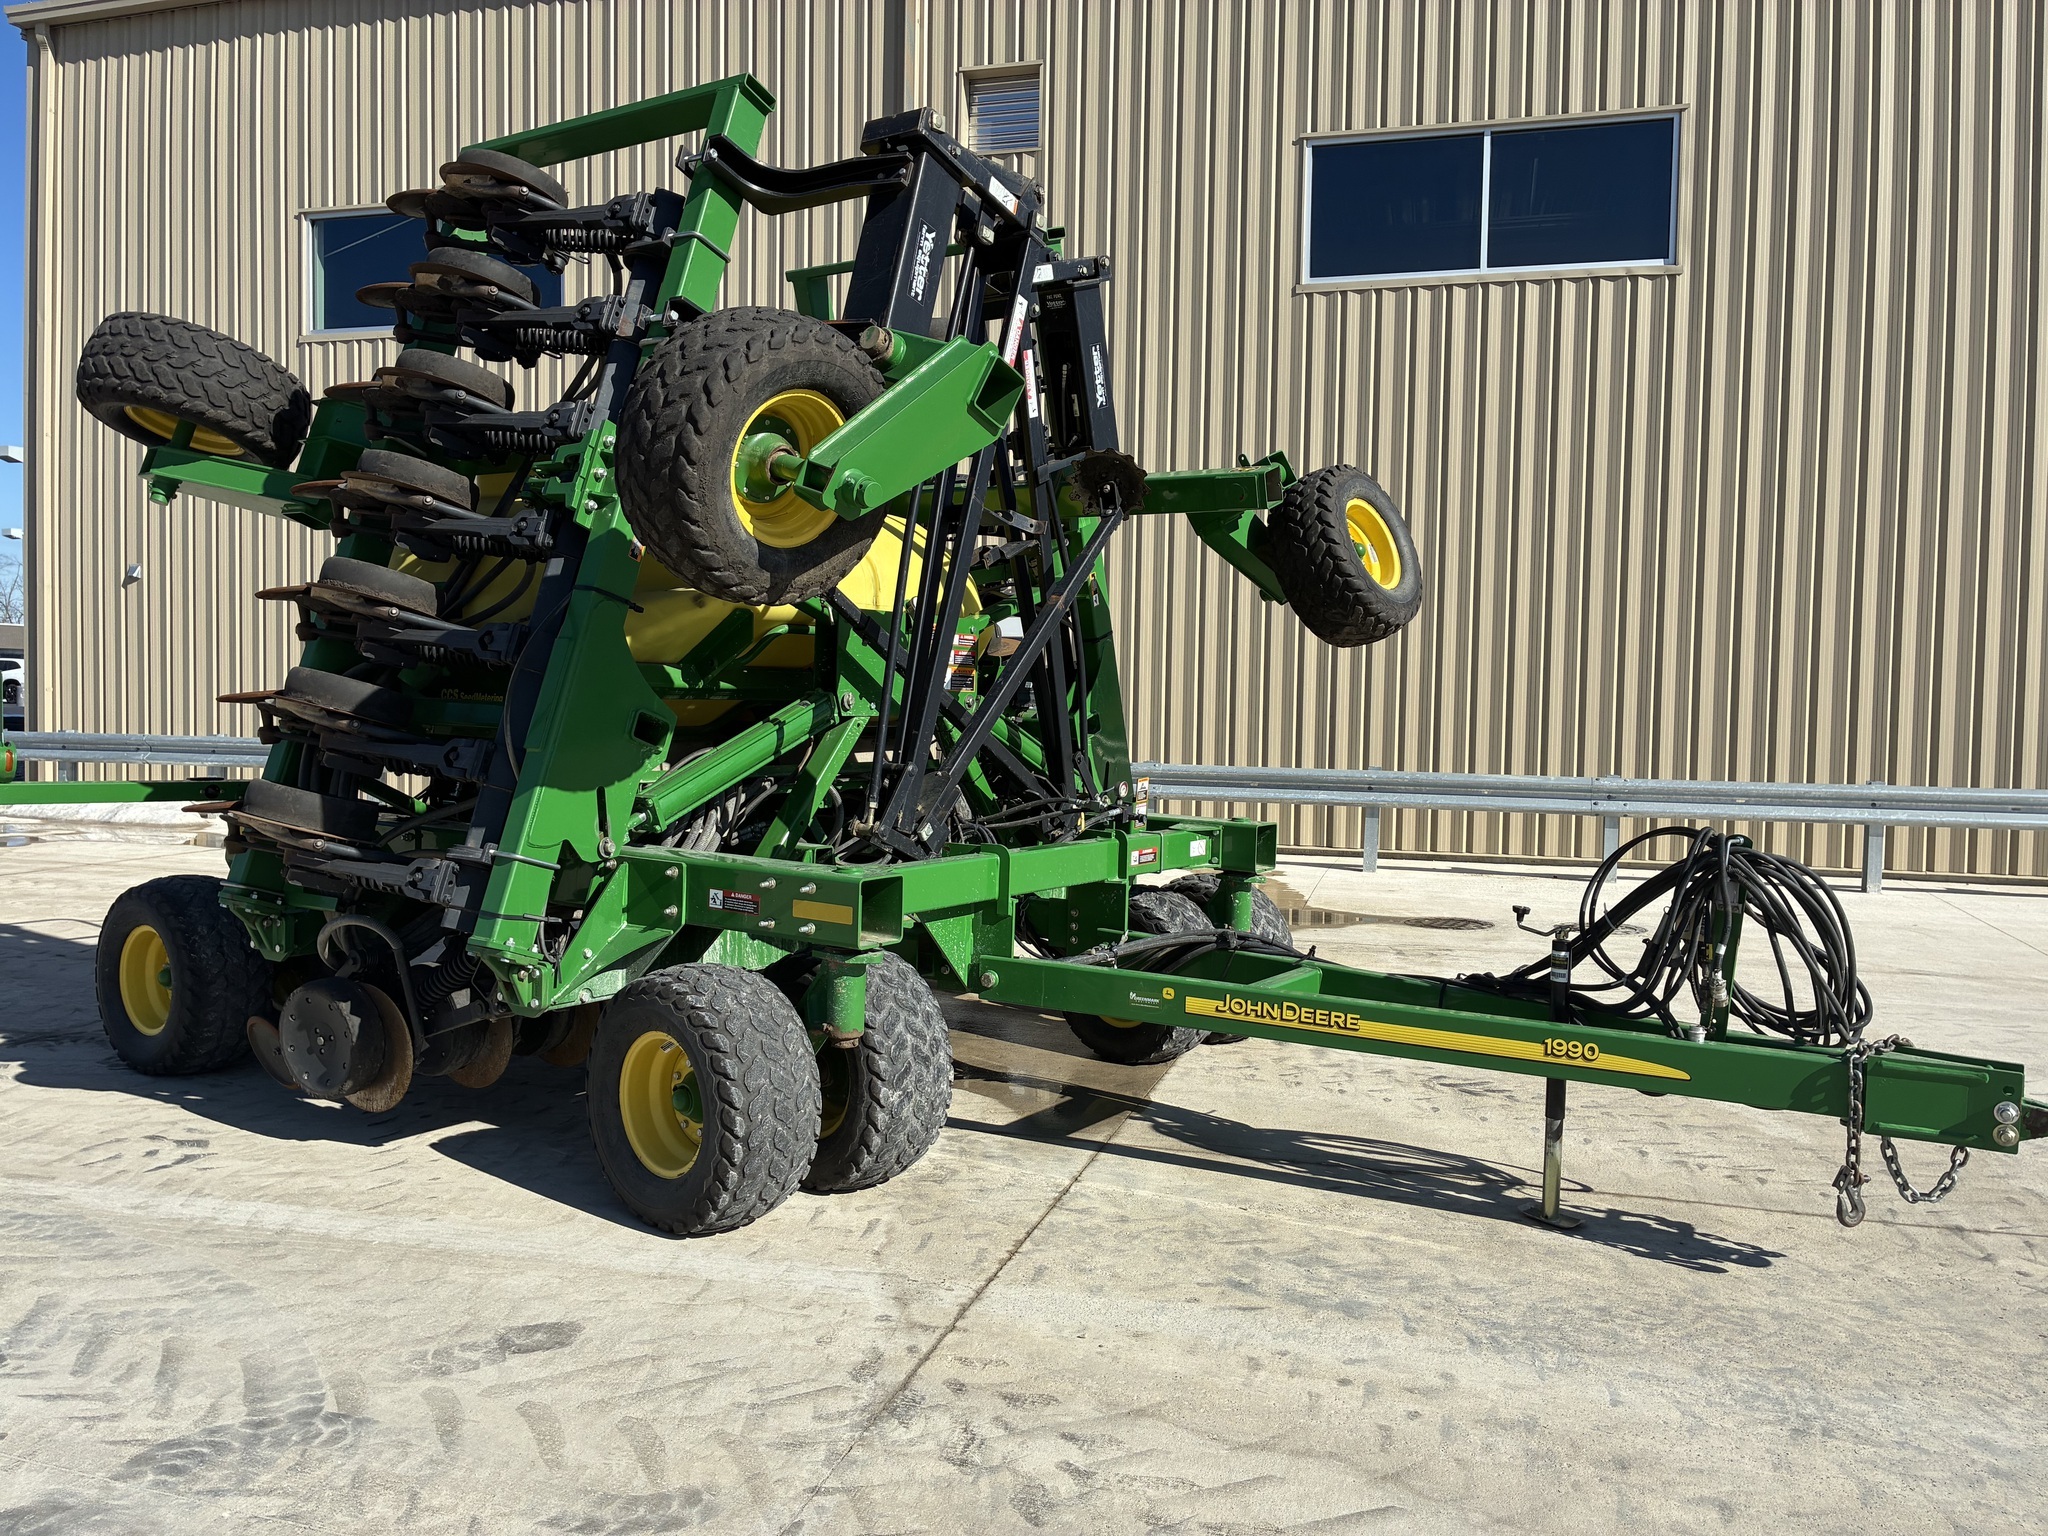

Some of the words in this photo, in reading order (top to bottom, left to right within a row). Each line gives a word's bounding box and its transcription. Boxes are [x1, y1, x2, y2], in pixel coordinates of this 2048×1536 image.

[916, 231, 936, 301] Yetter
[441, 688, 459, 700] CCS
[1216, 993, 1278, 1019] JOHN
[1281, 1001, 1361, 1031] DEERE
[1543, 1037, 1599, 1062] 1990
